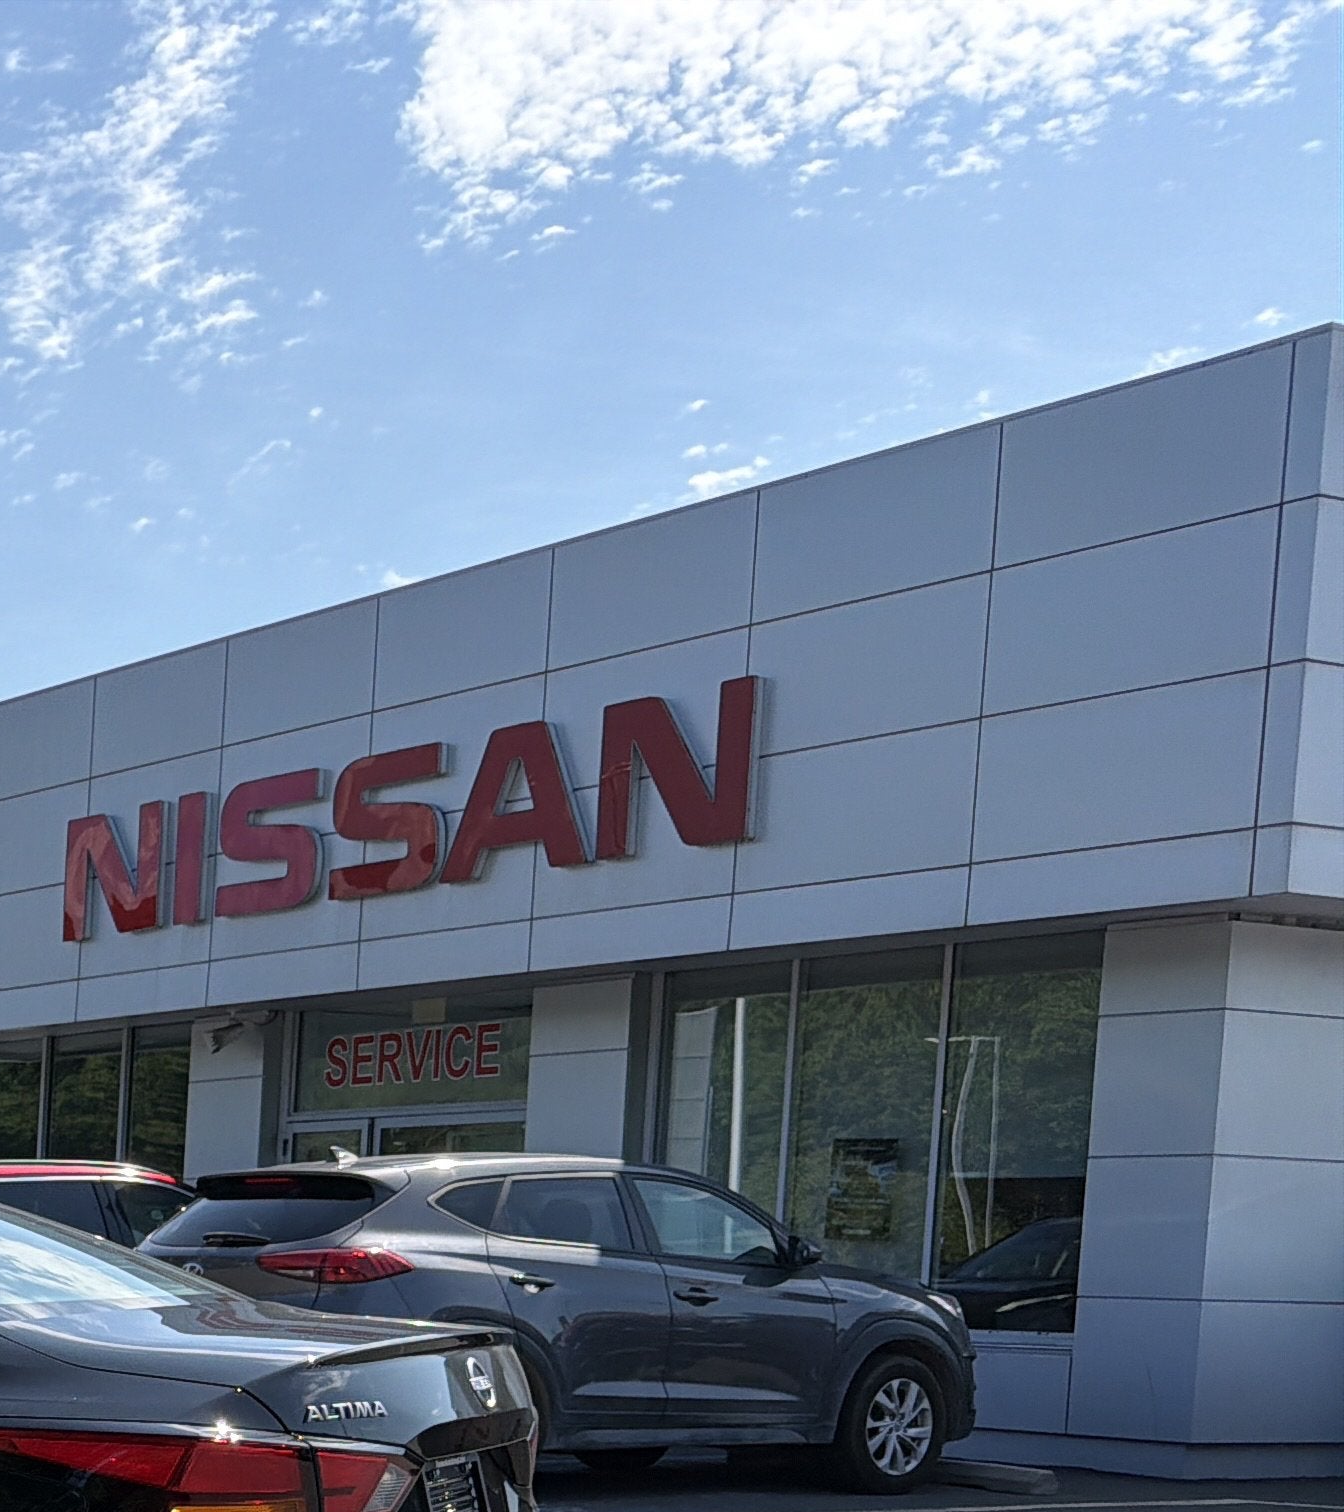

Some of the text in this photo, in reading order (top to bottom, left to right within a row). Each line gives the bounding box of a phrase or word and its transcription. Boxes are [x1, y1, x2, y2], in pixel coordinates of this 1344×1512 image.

[63, 675, 764, 942] NISSAN
[324, 1022, 501, 1089] SERVICE
[303, 1400, 388, 1423] ALTIMA
